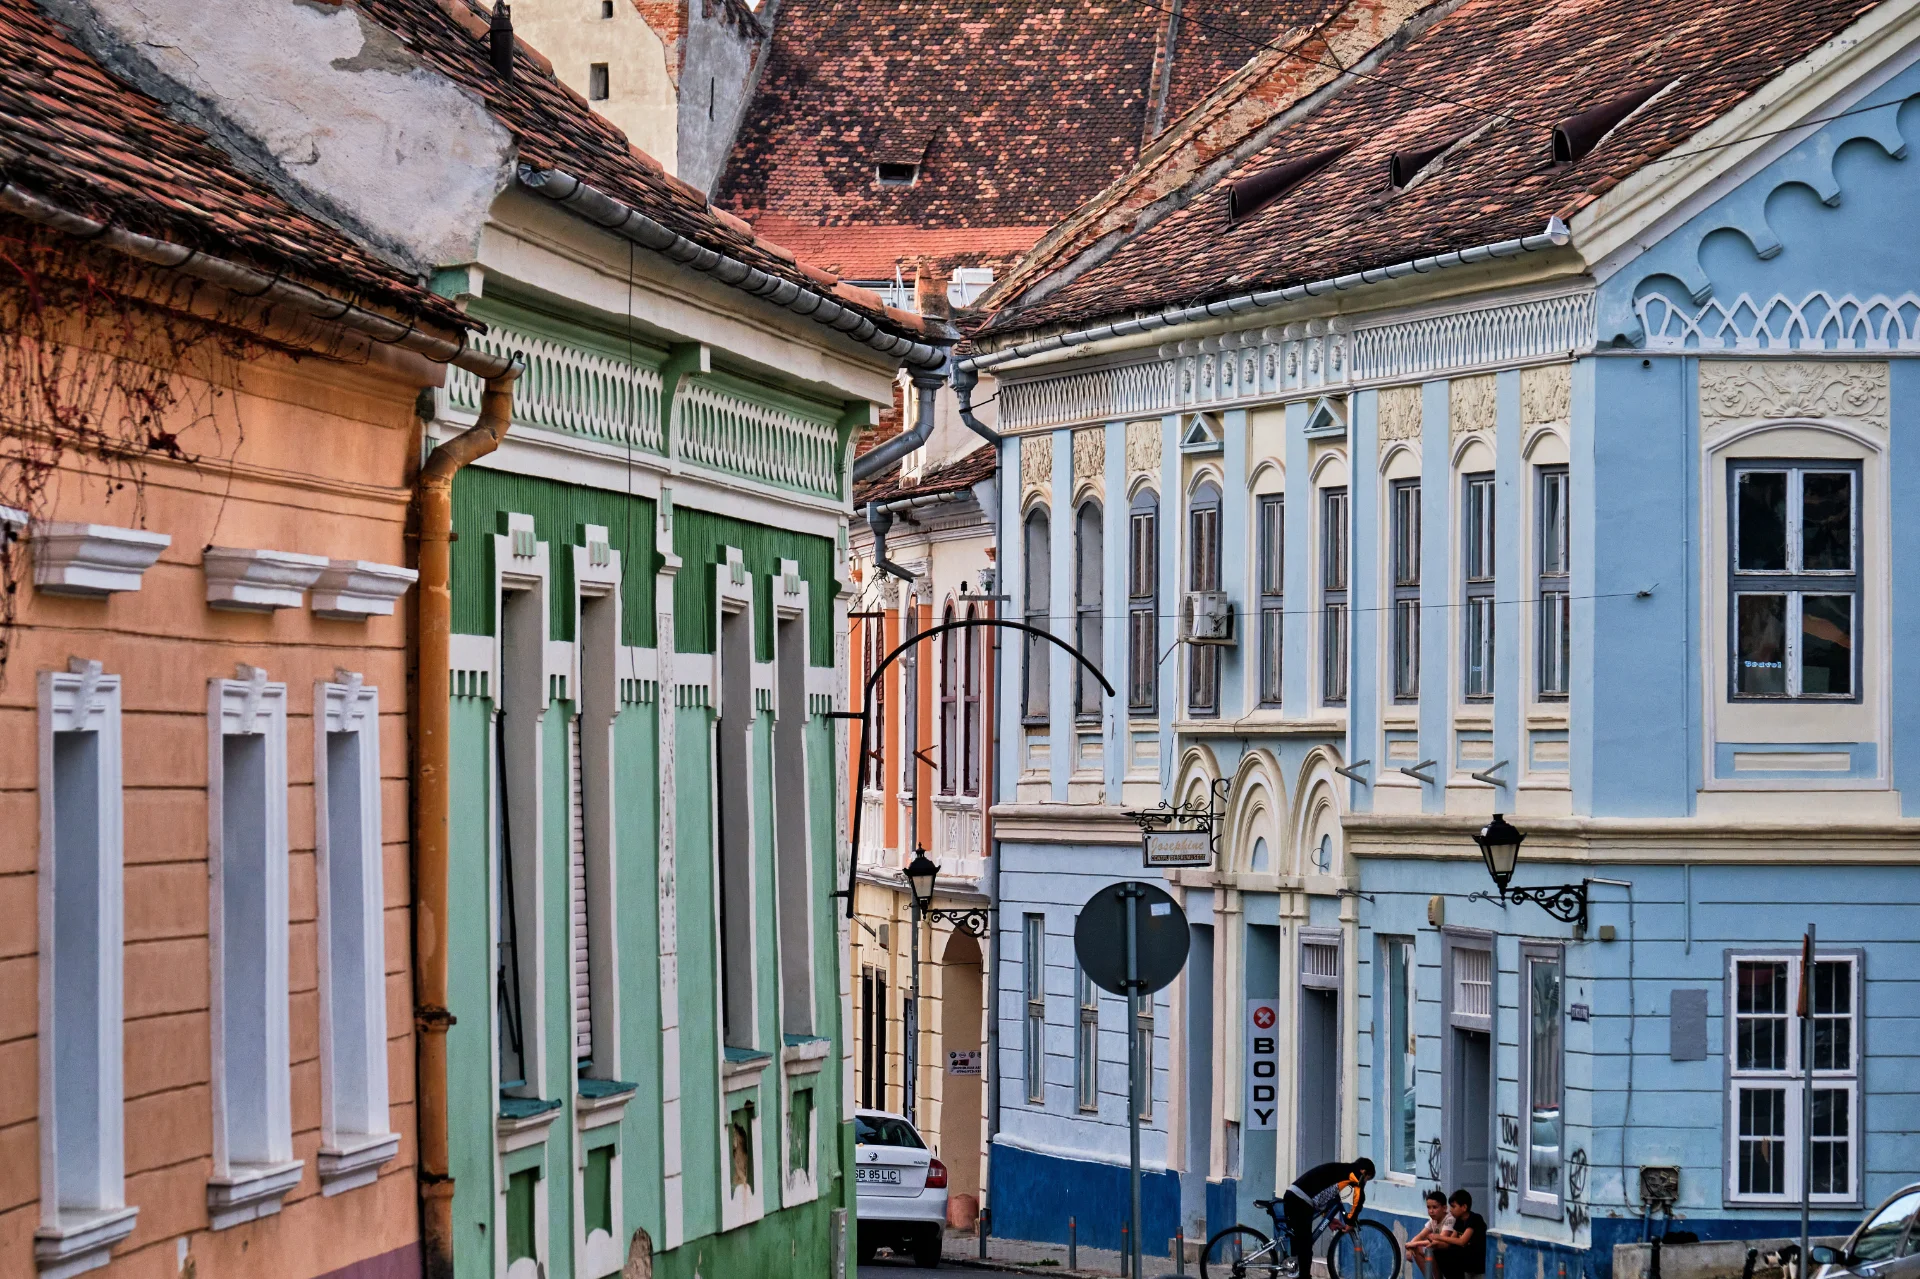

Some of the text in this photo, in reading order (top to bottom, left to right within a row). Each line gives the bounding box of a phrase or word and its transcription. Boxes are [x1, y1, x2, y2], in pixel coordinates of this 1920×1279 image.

[1151, 836, 1205, 855] Josephine
[1253, 1037, 1275, 1125] BODY
[869, 1170, 880, 1179] 85
[881, 1170, 897, 1180] LIC
